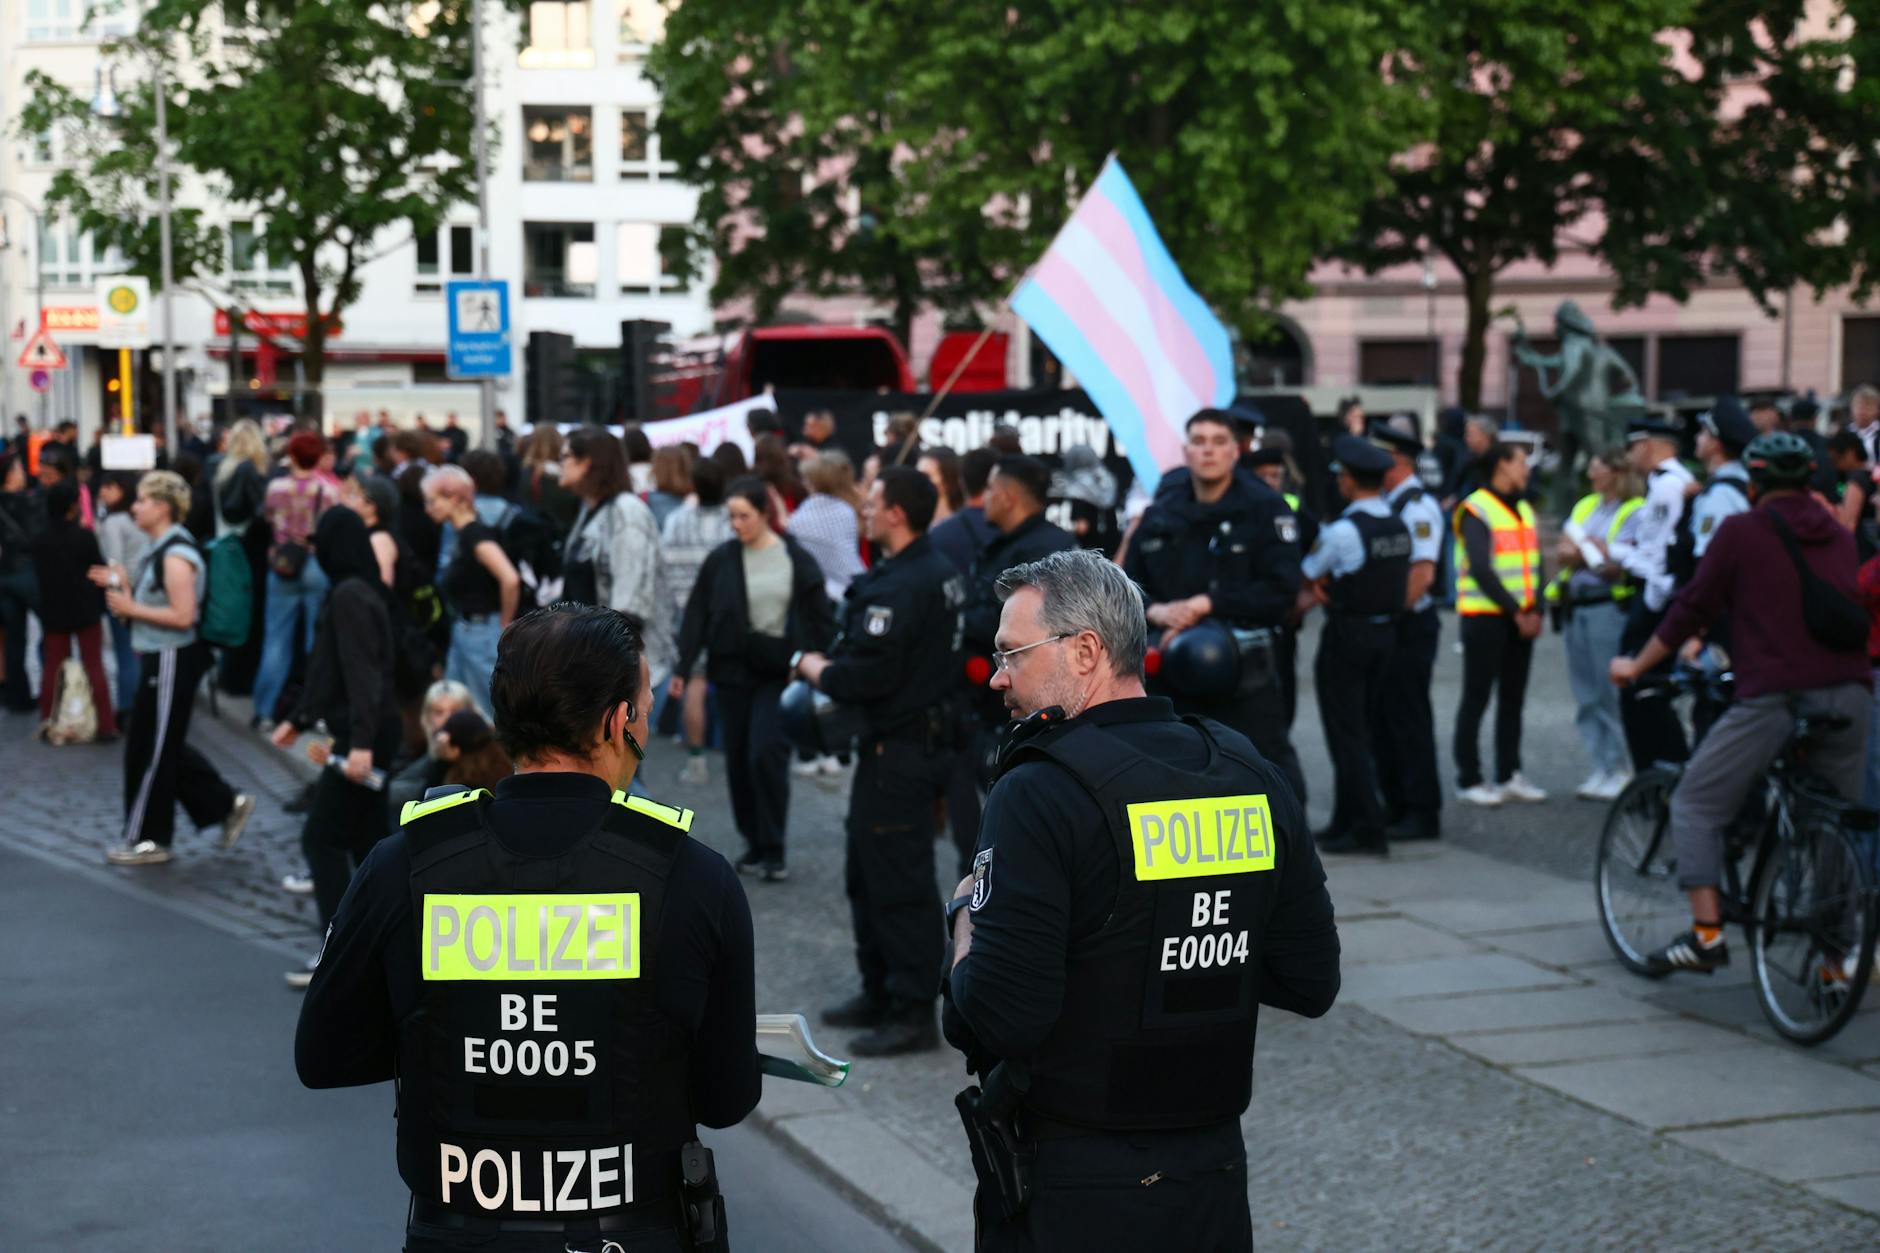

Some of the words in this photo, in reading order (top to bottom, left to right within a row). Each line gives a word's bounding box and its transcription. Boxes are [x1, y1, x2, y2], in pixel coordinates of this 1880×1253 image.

[1140, 806, 1270, 867] POLIZEI
[1191, 890, 1232, 927] BE
[430, 904, 632, 971] POLIZEI
[1160, 930, 1249, 971] E0004
[500, 993, 558, 1032] BE
[464, 1036, 597, 1077] E0005
[440, 1142, 634, 1212] POLIZEI
